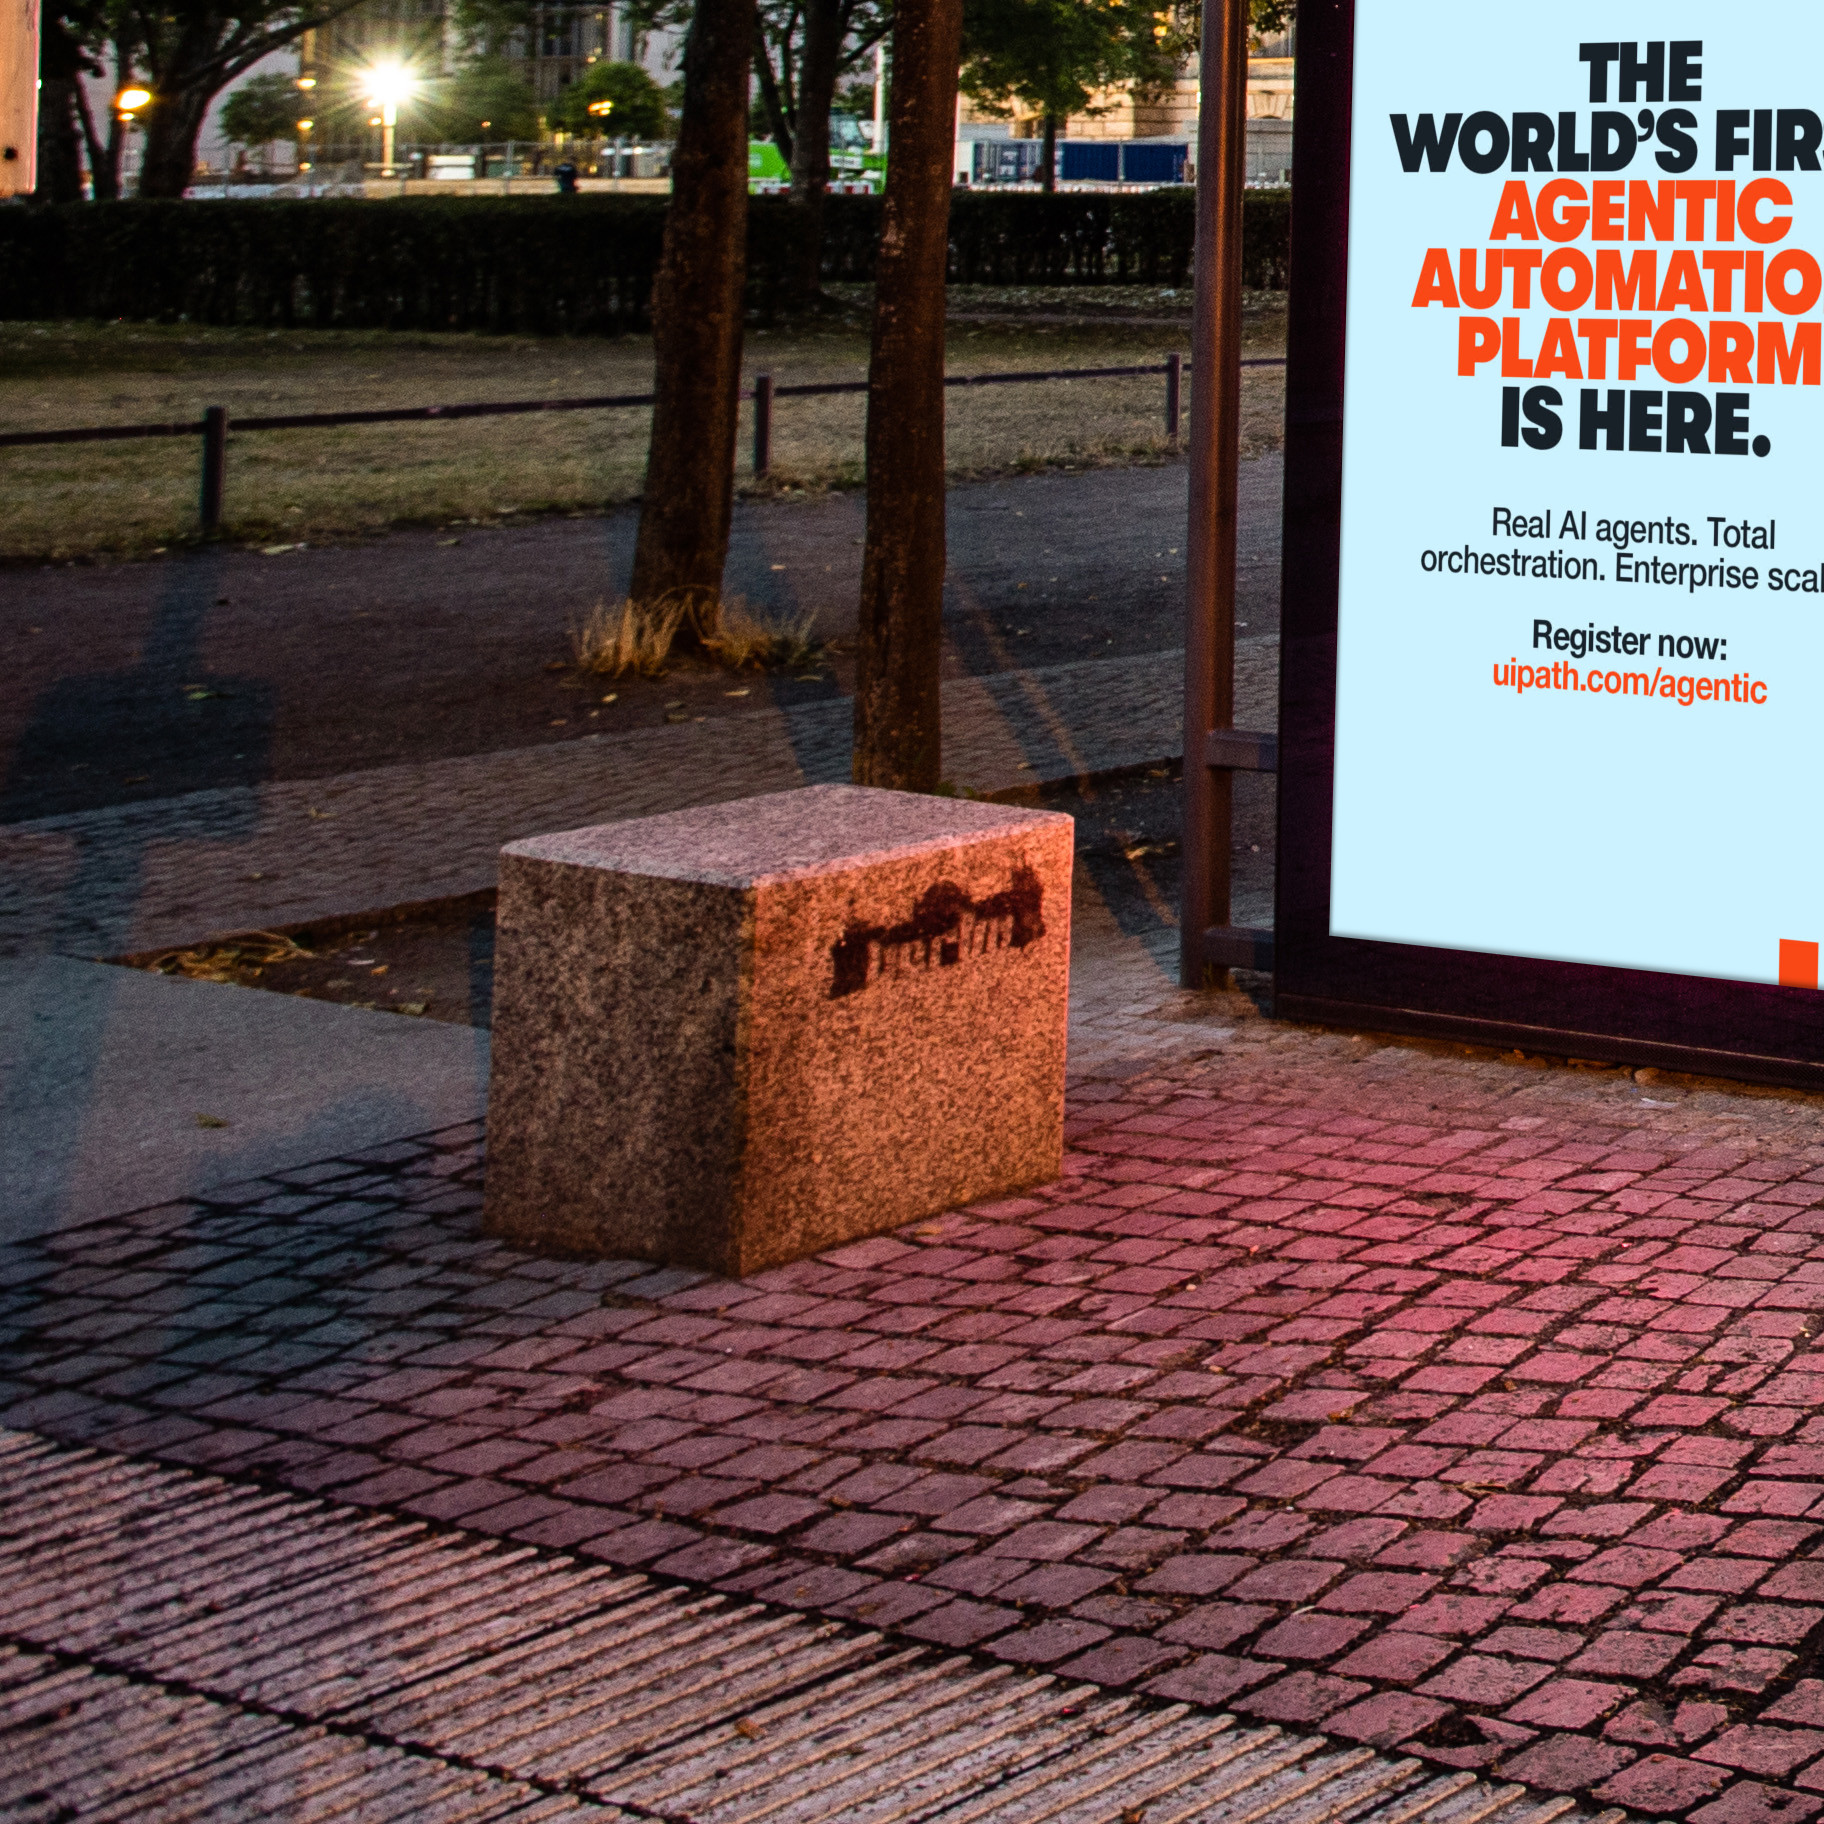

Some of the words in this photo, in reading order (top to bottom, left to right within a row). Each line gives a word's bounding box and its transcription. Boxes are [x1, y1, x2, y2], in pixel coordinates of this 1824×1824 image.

[1579, 40, 1703, 104] THE
[1489, 177, 1793, 244] AGENTIC
[1458, 316, 1822, 386] PLATFORM
[1501, 385, 1563, 451] IS
[1579, 388, 1771, 457] HERE.
[1493, 507, 1551, 539] Real
[1558, 510, 1587, 541] AI
[1596, 516, 1698, 549] agents.
[1707, 517, 1775, 550] Total
[1421, 545, 1606, 582] orchestration.
[1616, 552, 1759, 593] Enterprise
[1533, 619, 1651, 659] Register
[1658, 634, 1727, 661] now:
[1494, 657, 1767, 706] uipath.com/agentic
